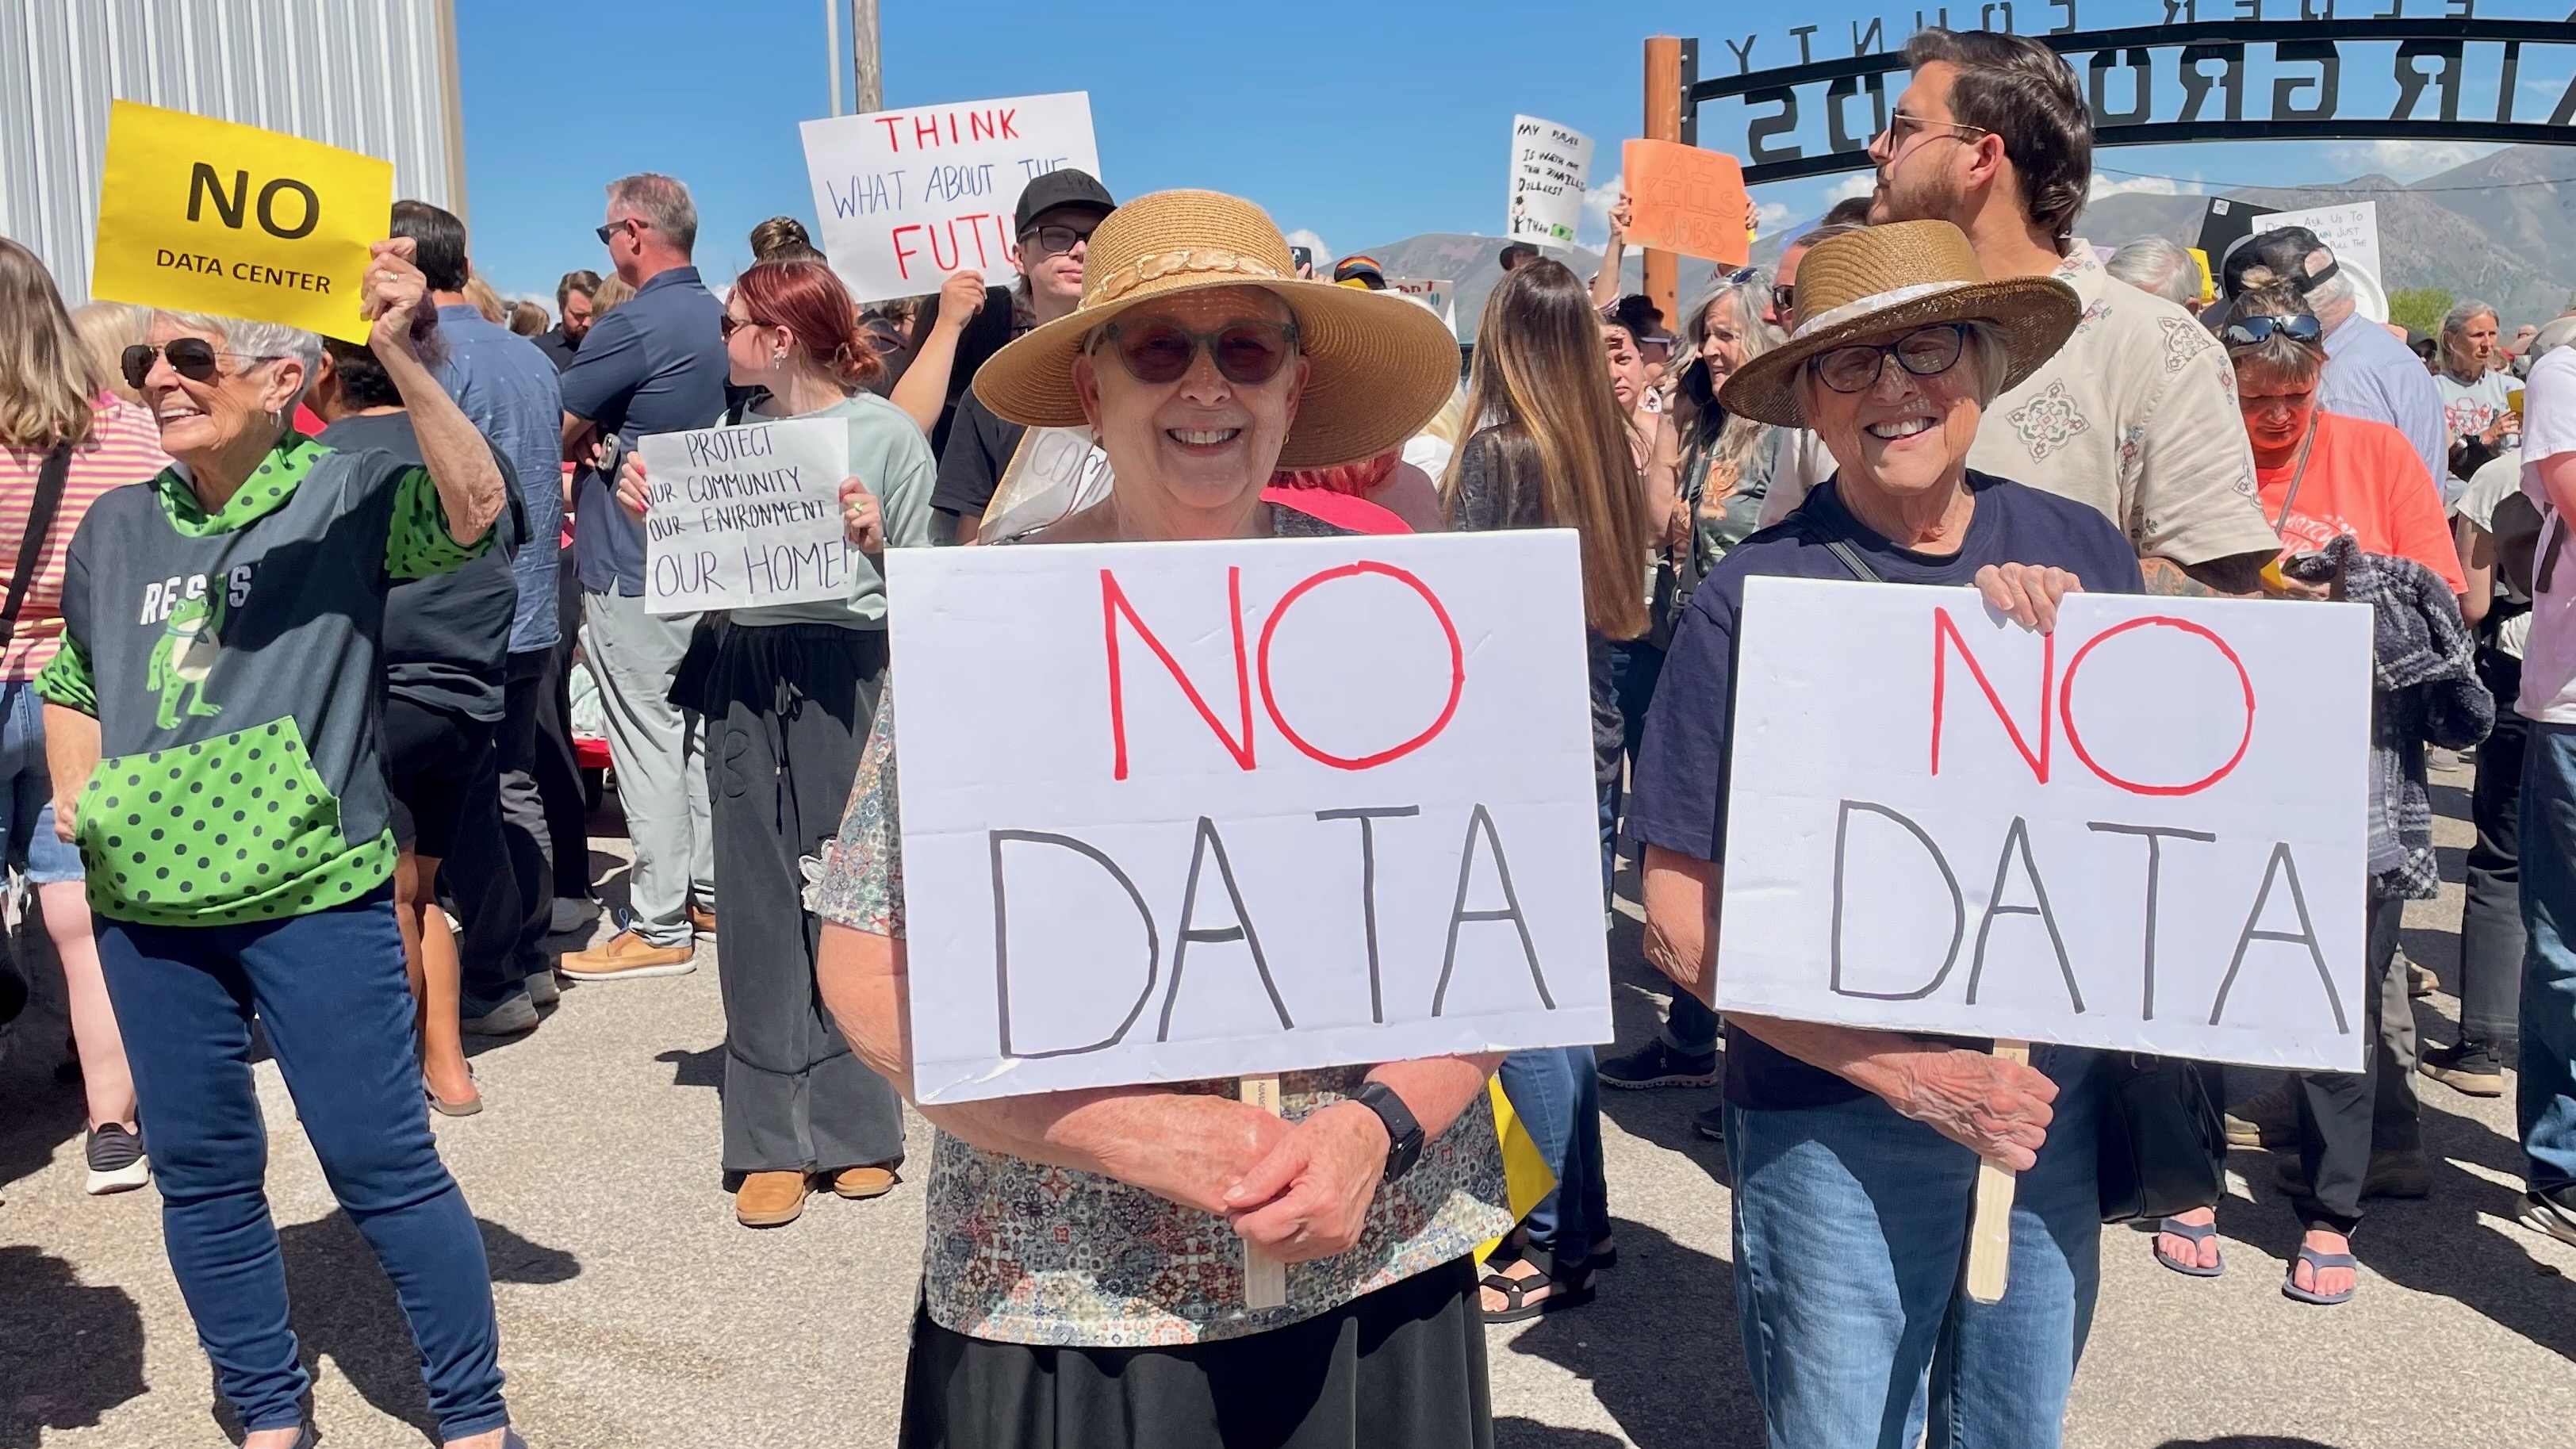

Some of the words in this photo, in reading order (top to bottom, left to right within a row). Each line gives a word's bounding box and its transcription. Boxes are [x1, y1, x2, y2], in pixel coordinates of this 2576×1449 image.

[875, 109, 1019, 152] THINK
[827, 171, 906, 219] WHAT
[925, 164, 995, 202] ABOUT
[1664, 149, 1715, 186] AI
[186, 162, 320, 240] NO
[1642, 176, 1738, 219] KILLS
[891, 213, 1016, 280] FUTU
[1659, 211, 1726, 254] JOBS
[156, 248, 224, 277] DATA
[232, 262, 331, 294] CENTER
[684, 424, 772, 467] PROTECT
[687, 466, 802, 504] COMMUNITY
[648, 516, 687, 542] OUR
[654, 550, 726, 597] OUR
[743, 535, 848, 594] HOME!
[1098, 558, 1466, 782] NO
[1930, 606, 2256, 797] NO
[988, 803, 1557, 1060] DATA
[1828, 798, 2351, 1036] DATA
